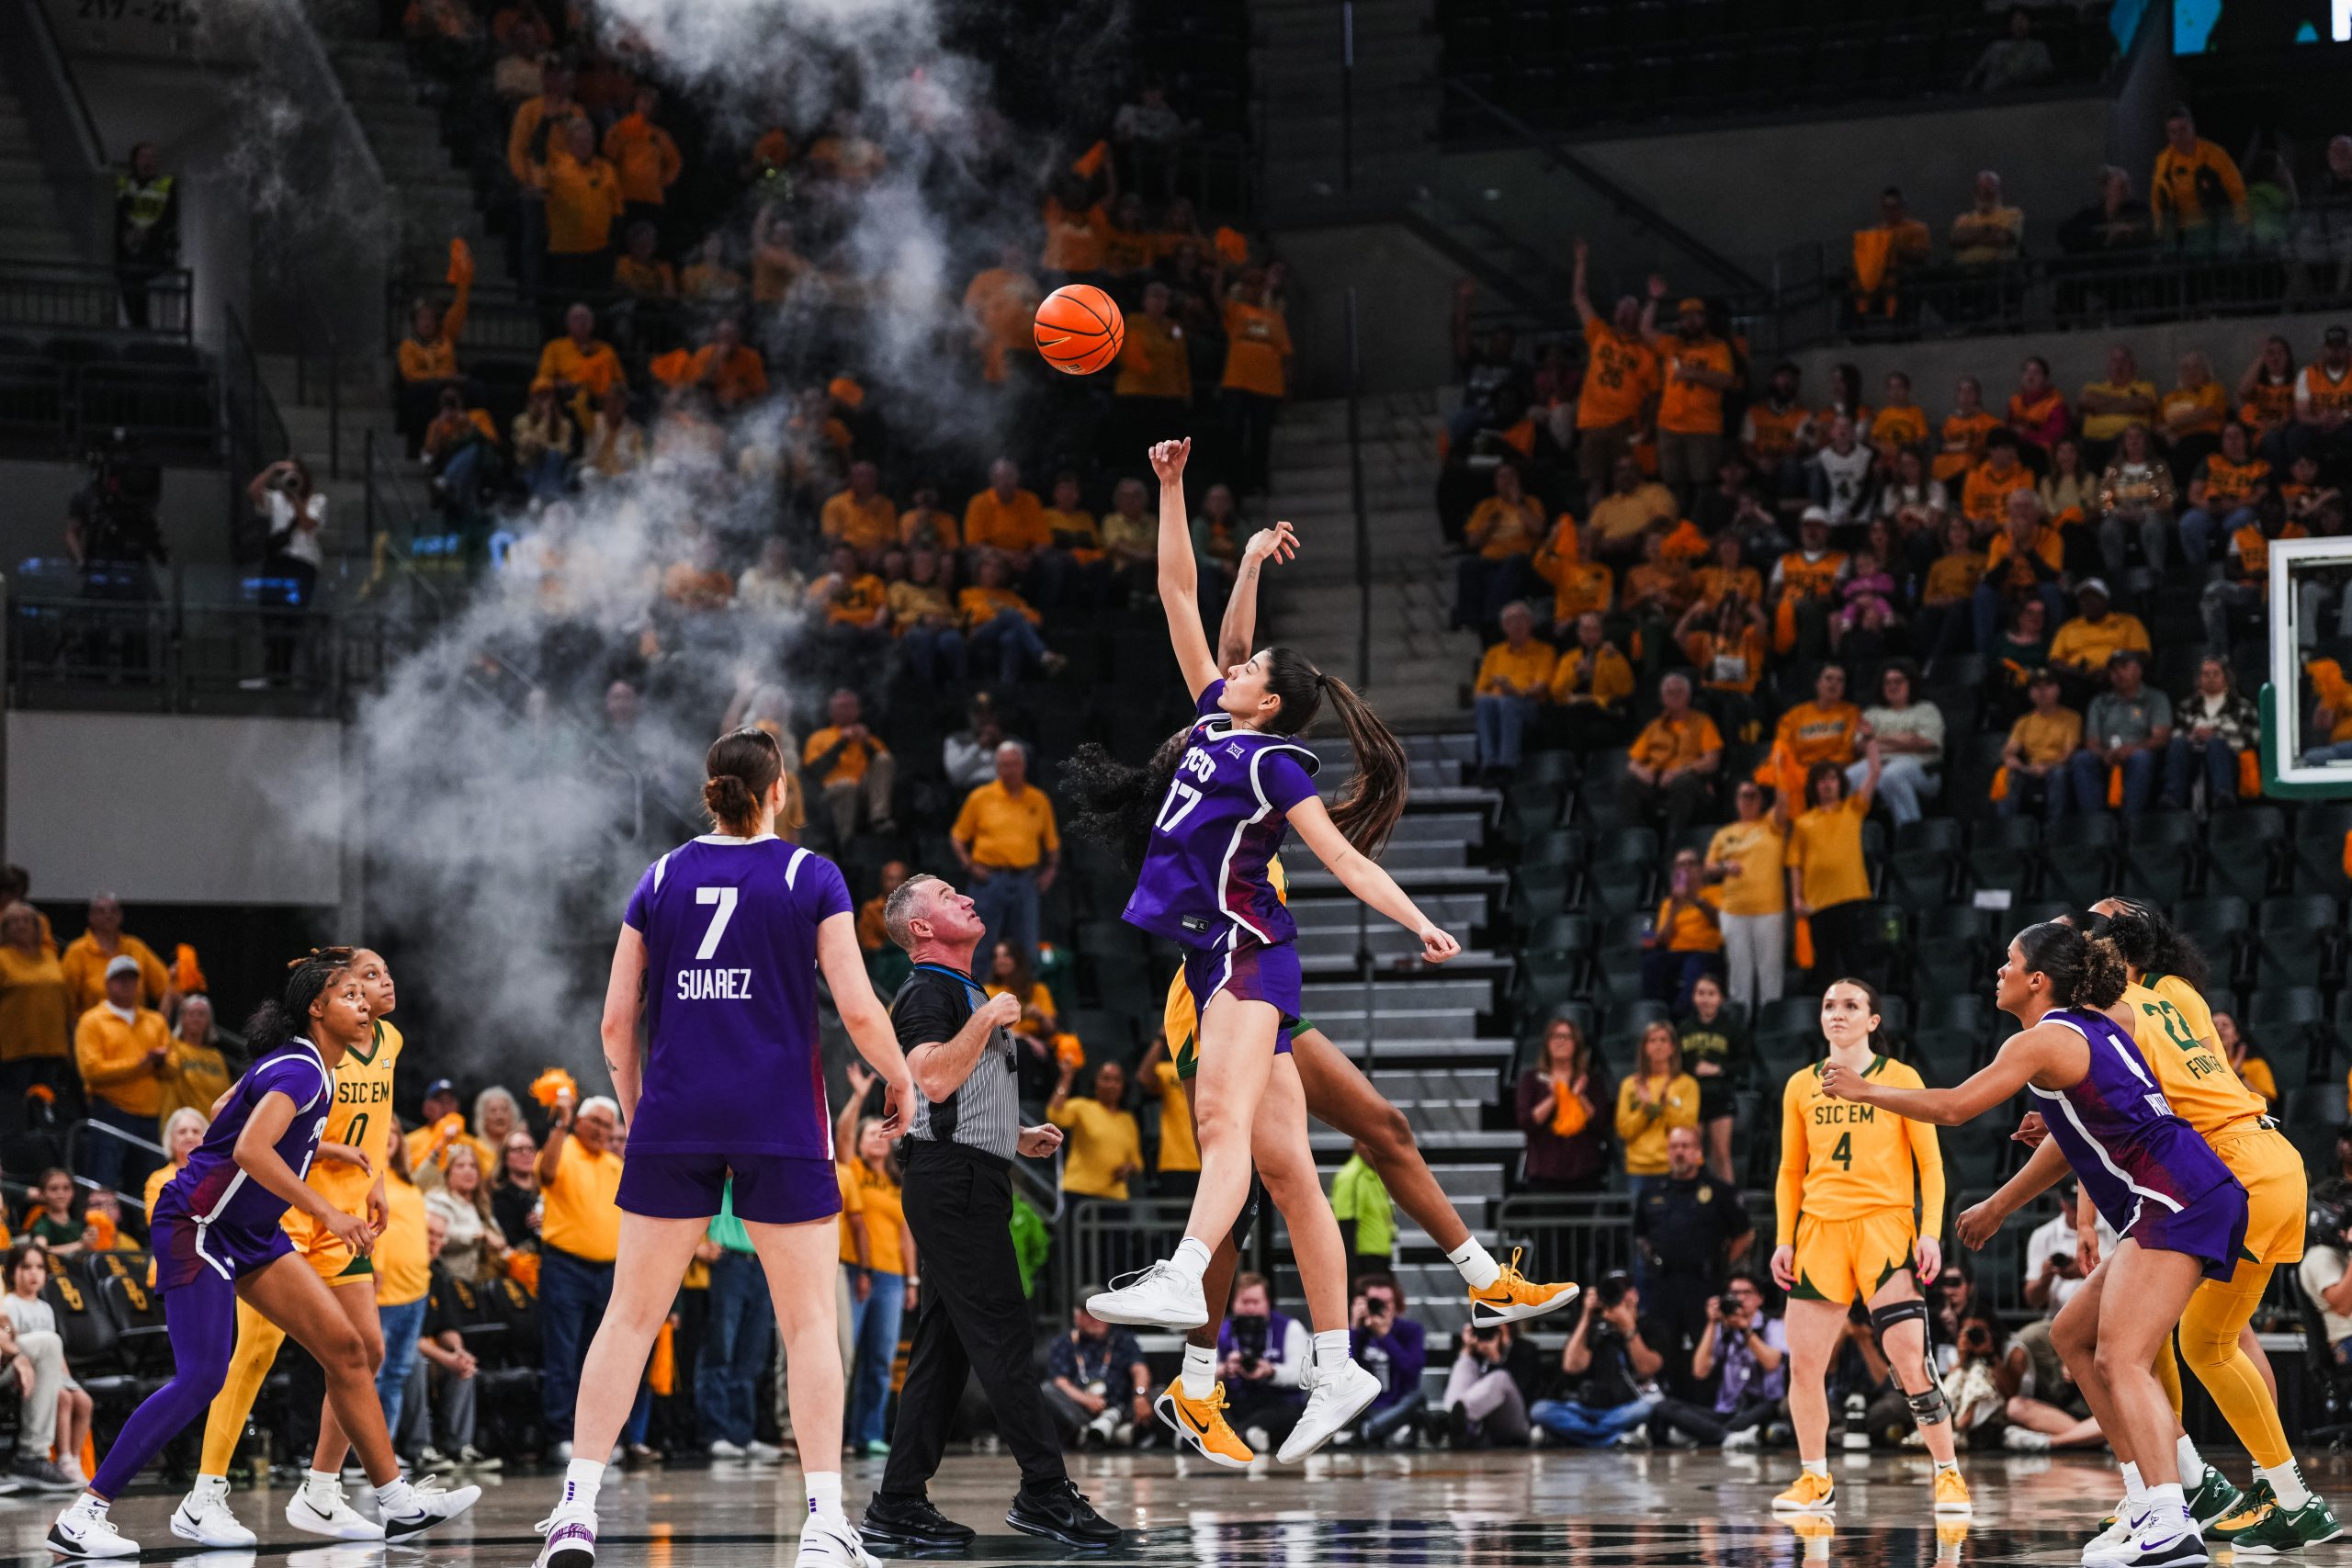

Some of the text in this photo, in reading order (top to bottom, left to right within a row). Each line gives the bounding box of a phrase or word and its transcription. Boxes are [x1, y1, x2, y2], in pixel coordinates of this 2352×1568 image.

[1179, 746, 1217, 784] TCU
[1155, 777, 1204, 833] 17
[695, 886, 739, 960] 7
[676, 968, 752, 1000] SUAREZ
[2142, 999, 2201, 1052] 22
[344, 1112, 369, 1147] 0
[1831, 1131, 1853, 1172] 4
